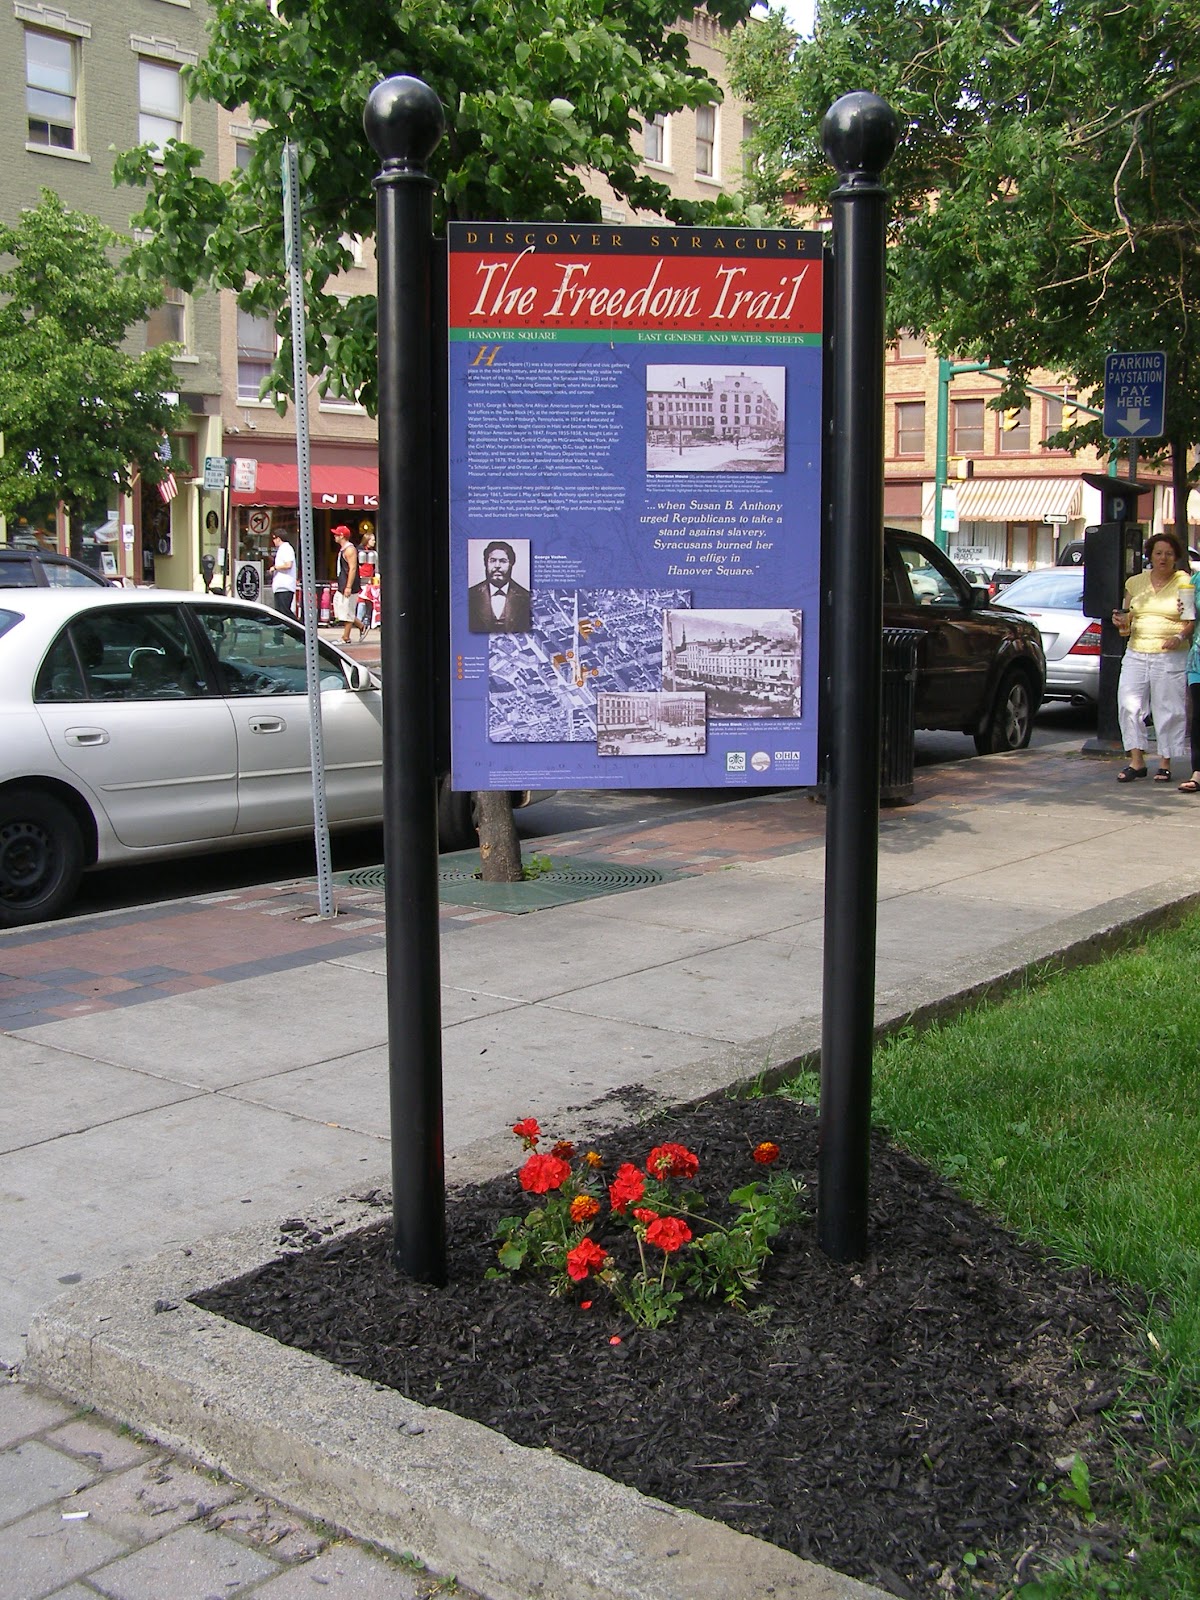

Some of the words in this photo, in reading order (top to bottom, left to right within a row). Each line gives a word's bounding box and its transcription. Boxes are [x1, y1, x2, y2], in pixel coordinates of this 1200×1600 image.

[467, 232, 623, 246] DISCOVER
[651, 236, 806, 250] SYRACUSE
[469, 245, 538, 316] The
[543, 258, 702, 318] Freedom
[708, 264, 810, 320] Trail
[468, 331, 514, 339] HANOVER
[518, 332, 557, 340] SQUARE
[638, 333, 662, 341] EAST
[664, 333, 704, 342] GENESEE
[731, 335, 762, 343] WATER
[1110, 357, 1160, 370] PARKING
[1108, 370, 1162, 384] PAYSTATION
[1120, 386, 1148, 396] PAY
[1116, 396, 1151, 407] HERE
[206, 459, 211, 468] 2
[690, 500, 721, 510] Susan
[725, 500, 735, 510] B.
[740, 501, 783, 512] Anthony
[1113, 497, 1124, 519] P
[640, 514, 669, 524] urged
[672, 513, 736, 524] Republicans
[740, 515, 748, 523] to
[752, 515, 773, 523] take
[658, 527, 686, 536] stand
[689, 527, 724, 537] against
[728, 528, 766, 537] slavery.
[653, 539, 713, 550] Syracusans
[716, 540, 752, 549] burned
[756, 540, 773, 550] her
[686, 554, 696, 562] in
[700, 553, 727, 563] effigy
[731, 554, 740, 562] in
[668, 565, 712, 575] Hanover
